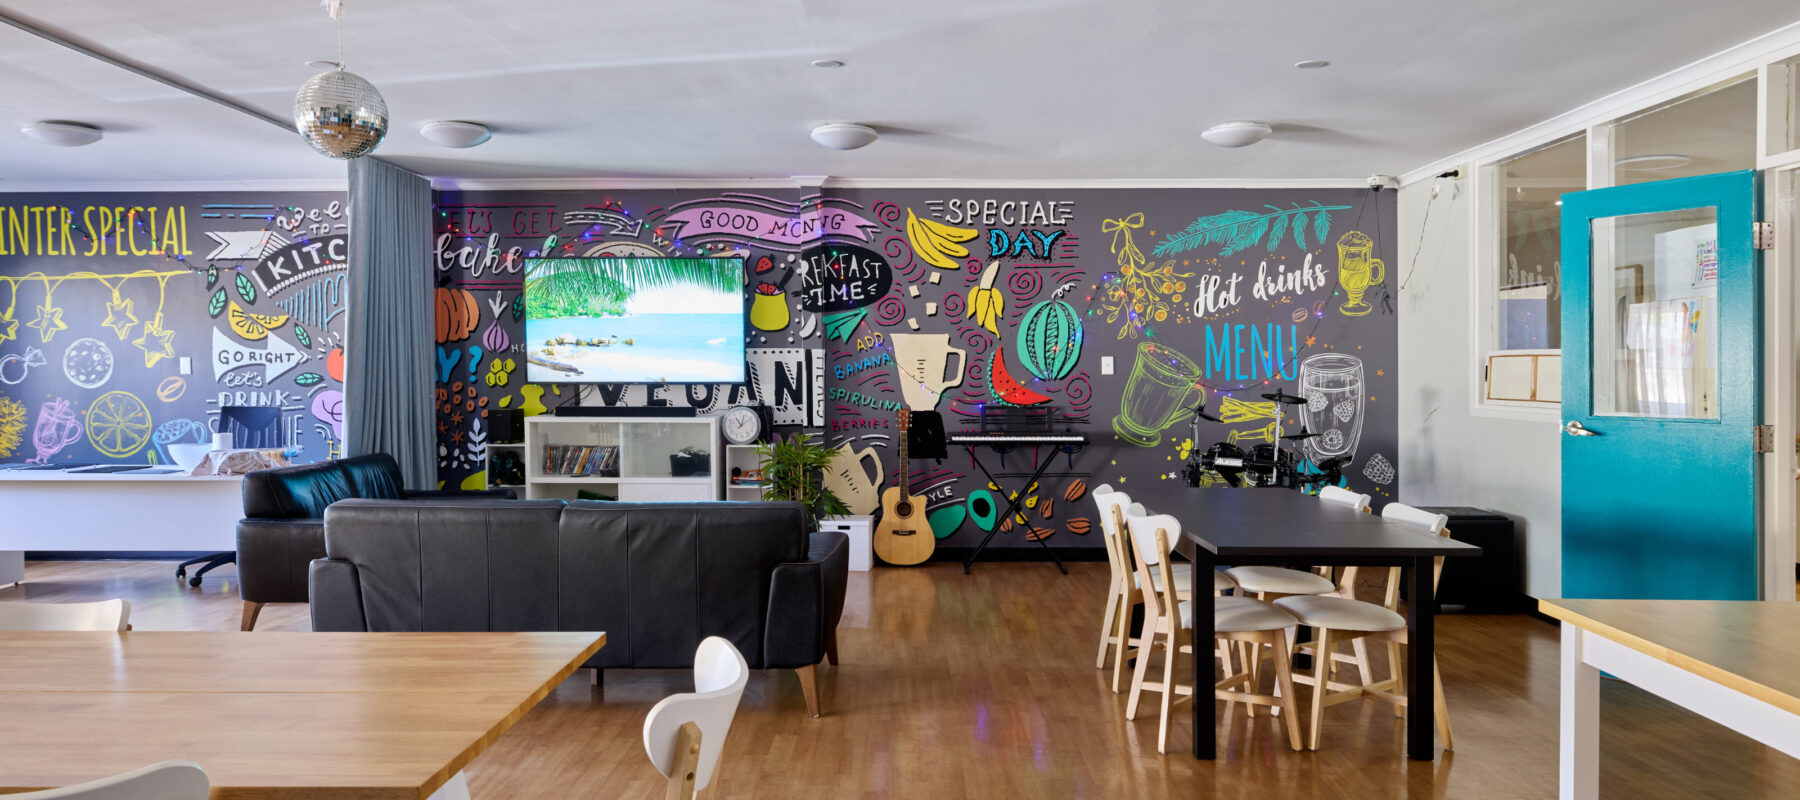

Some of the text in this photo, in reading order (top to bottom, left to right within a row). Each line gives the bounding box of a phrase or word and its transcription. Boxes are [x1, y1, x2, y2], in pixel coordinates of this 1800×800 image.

[512, 207, 562, 233] GET
[700, 211, 758, 232] GOOD
[945, 199, 1066, 225] SPECIAL
[0, 205, 192, 257] INTER SPECIAL
[309, 223, 330, 235] TO
[988, 228, 1066, 258] DAY
[267, 238, 347, 281] KITC
[1193, 252, 1330, 318] Hot drinks
[857, 331, 884, 352] ADD
[1204, 322, 1299, 382] MENU
[218, 349, 295, 365] GO RIGHT
[833, 352, 891, 380] BANANA
[218, 389, 290, 407] DRINK
[828, 386, 902, 412] SPIRULINA
[831, 416, 889, 431] BERRIES
